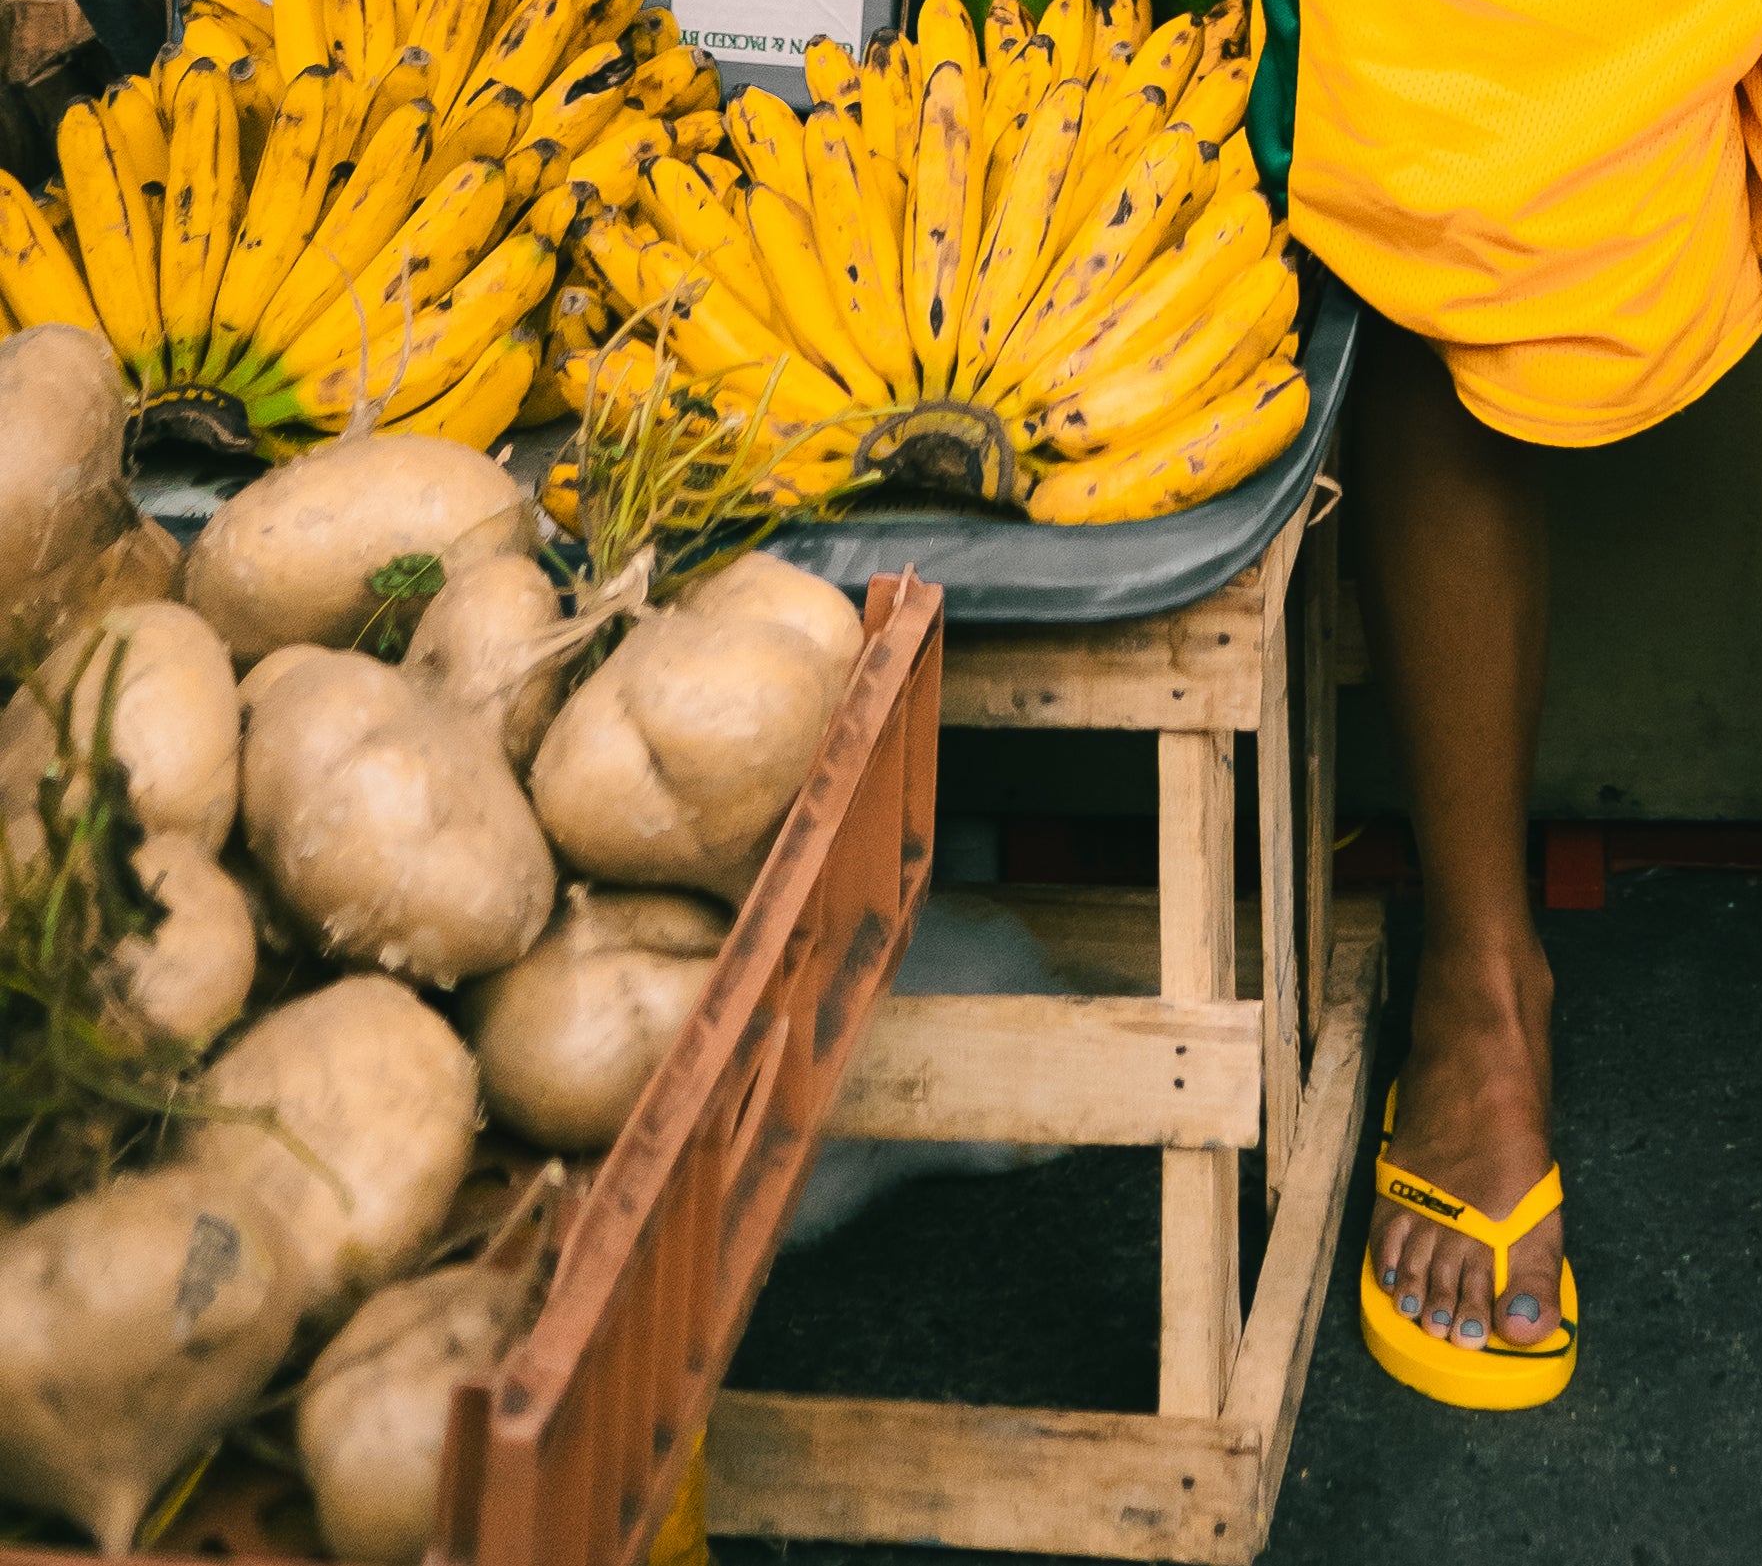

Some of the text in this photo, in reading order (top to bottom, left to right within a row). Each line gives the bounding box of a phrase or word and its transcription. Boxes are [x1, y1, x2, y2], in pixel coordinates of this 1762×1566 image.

[679, 29, 700, 46] BY
[704, 32, 767, 53] PACKED
[771, 36, 786, 54] &
